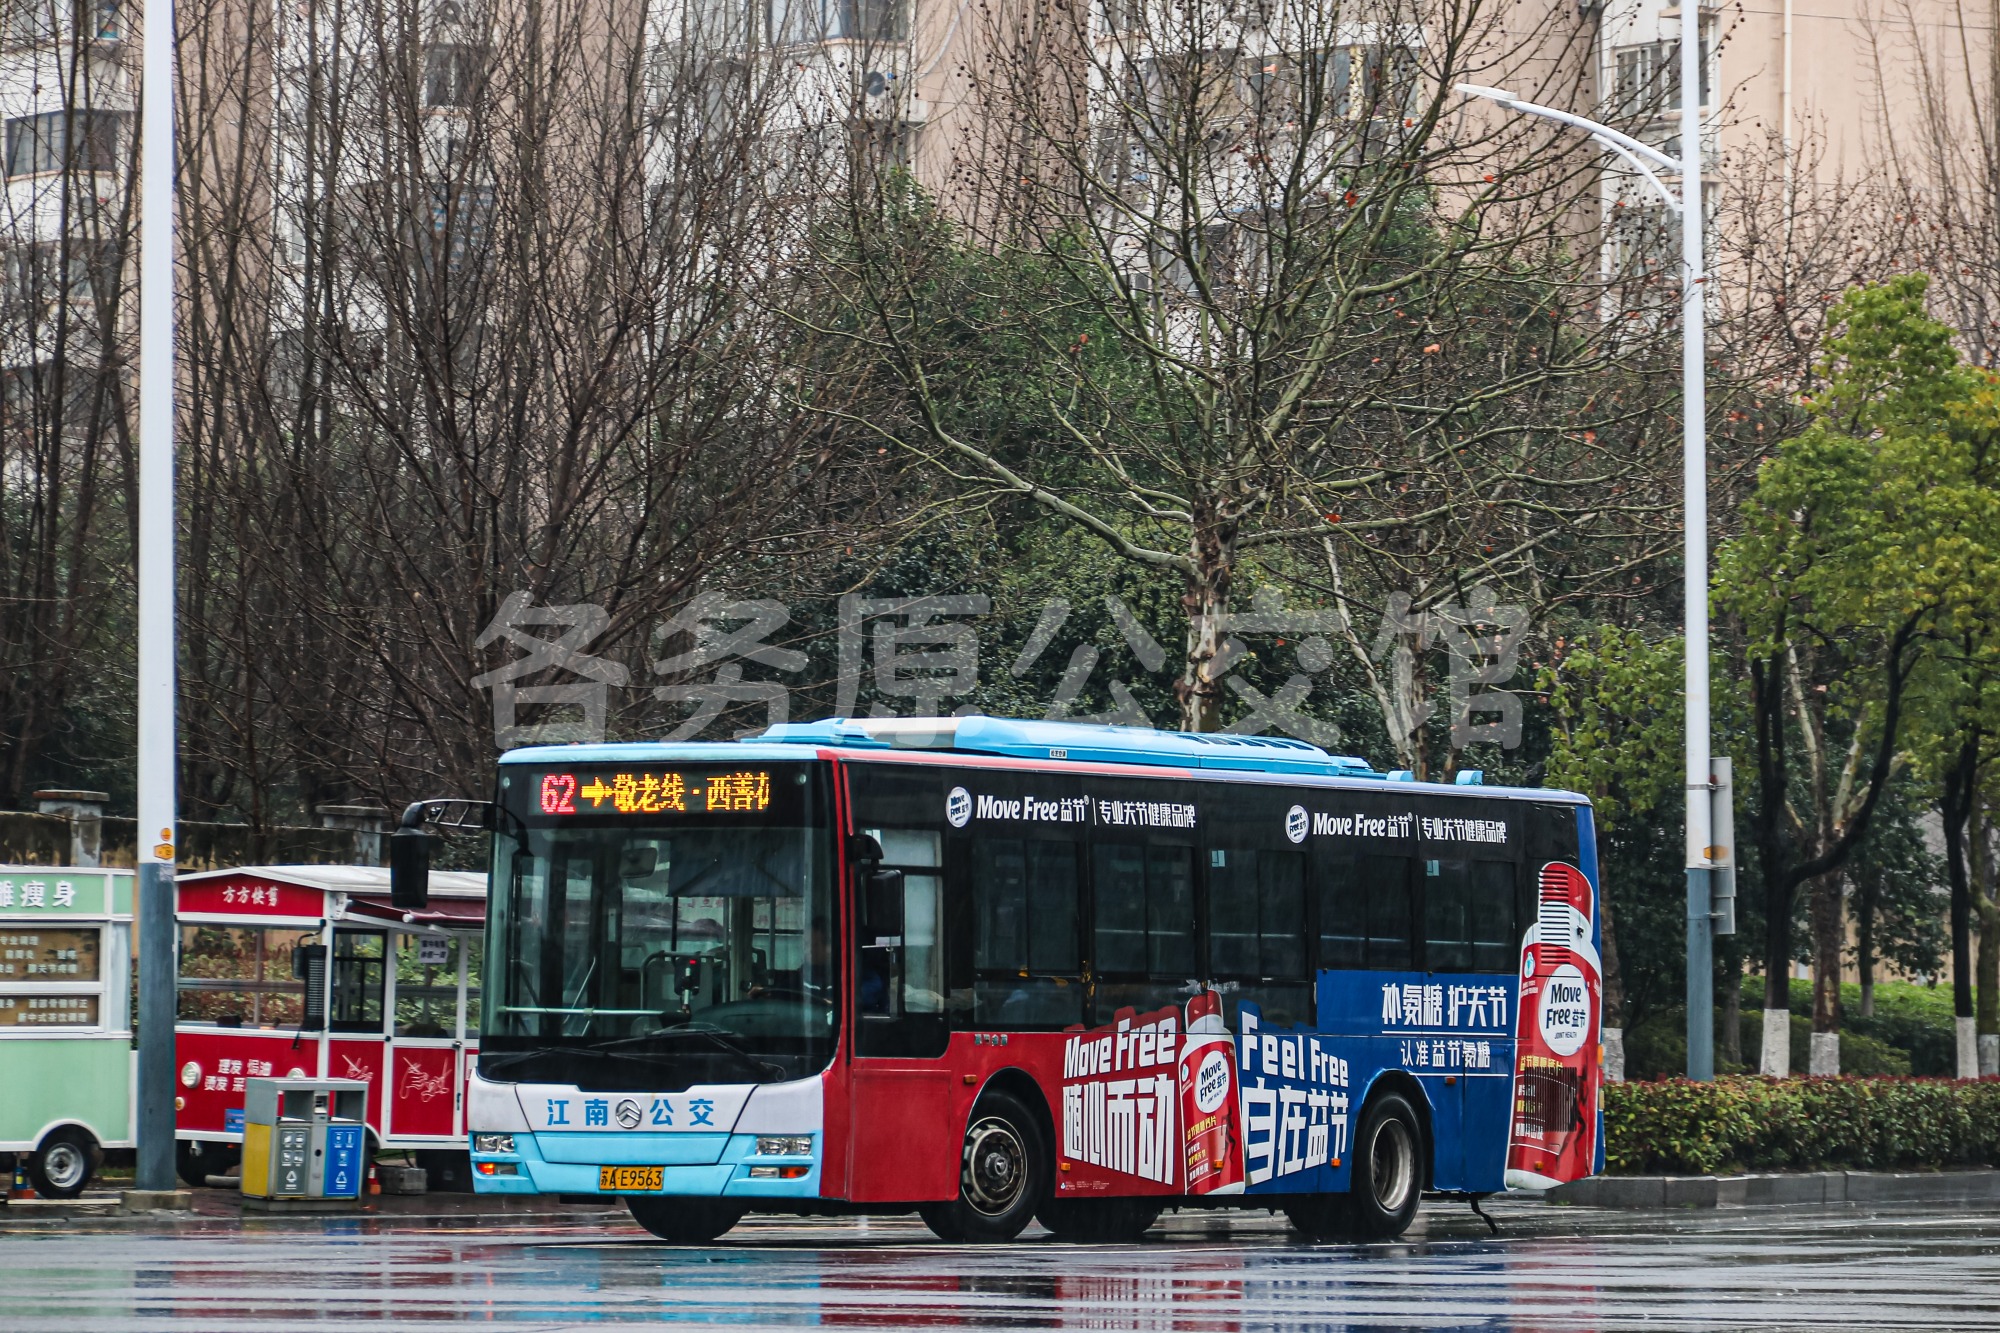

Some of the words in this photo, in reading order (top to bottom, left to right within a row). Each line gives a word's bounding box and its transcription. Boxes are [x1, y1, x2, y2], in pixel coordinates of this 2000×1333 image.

[541, 774, 575, 812] 62
[976, 794, 1021, 820] Move
[1023, 796, 1059, 821] Free
[1098, 800, 1196, 828] 专业关节健康品牌
[1312, 812, 1353, 836] Move
[1354, 813, 1386, 837] Free
[1421, 817, 1507, 843] 专业关节健康品牌
[1382, 982, 1442, 1026] 补氨糖
[1447, 984, 1507, 1027] 护关节
[1550, 983, 1582, 1005] Move
[1546, 1008, 1571, 1029] Free
[1063, 1035, 1112, 1079] Move
[1115, 1016, 1177, 1072] Free
[1242, 1010, 1305, 1081] Feel
[1310, 1037, 1349, 1088] Free
[1201, 1060, 1222, 1085] Move
[1200, 1079, 1217, 1103] Free
[547, 1098, 714, 1127] 江南公交
[1062, 1073, 1175, 1186] 随心而动
[1240, 1076, 1349, 1187] 自在益节
